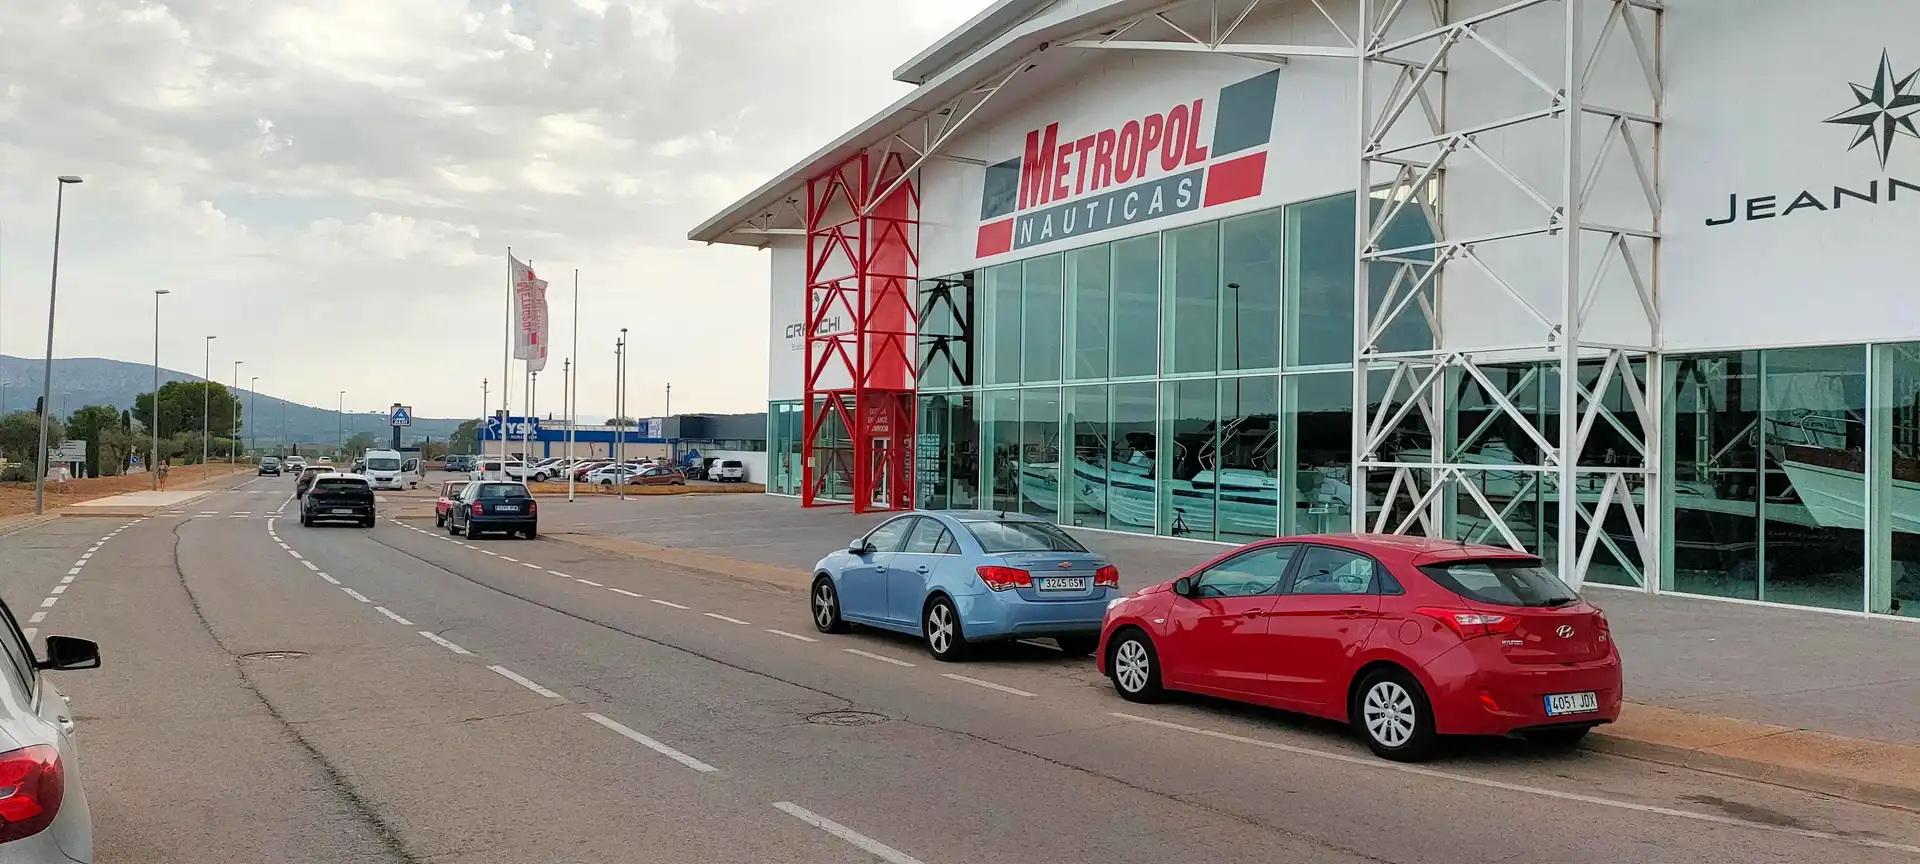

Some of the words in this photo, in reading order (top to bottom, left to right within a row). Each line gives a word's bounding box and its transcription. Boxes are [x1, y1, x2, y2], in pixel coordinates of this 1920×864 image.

[1018, 98, 1208, 211] METROPOL
[1020, 177, 1194, 245] NAUTICAS
[785, 316, 841, 339] CRCHI
[1046, 578, 1067, 588] 3245
[1553, 695, 1576, 710] 4051
[1579, 694, 1596, 708] JDX
